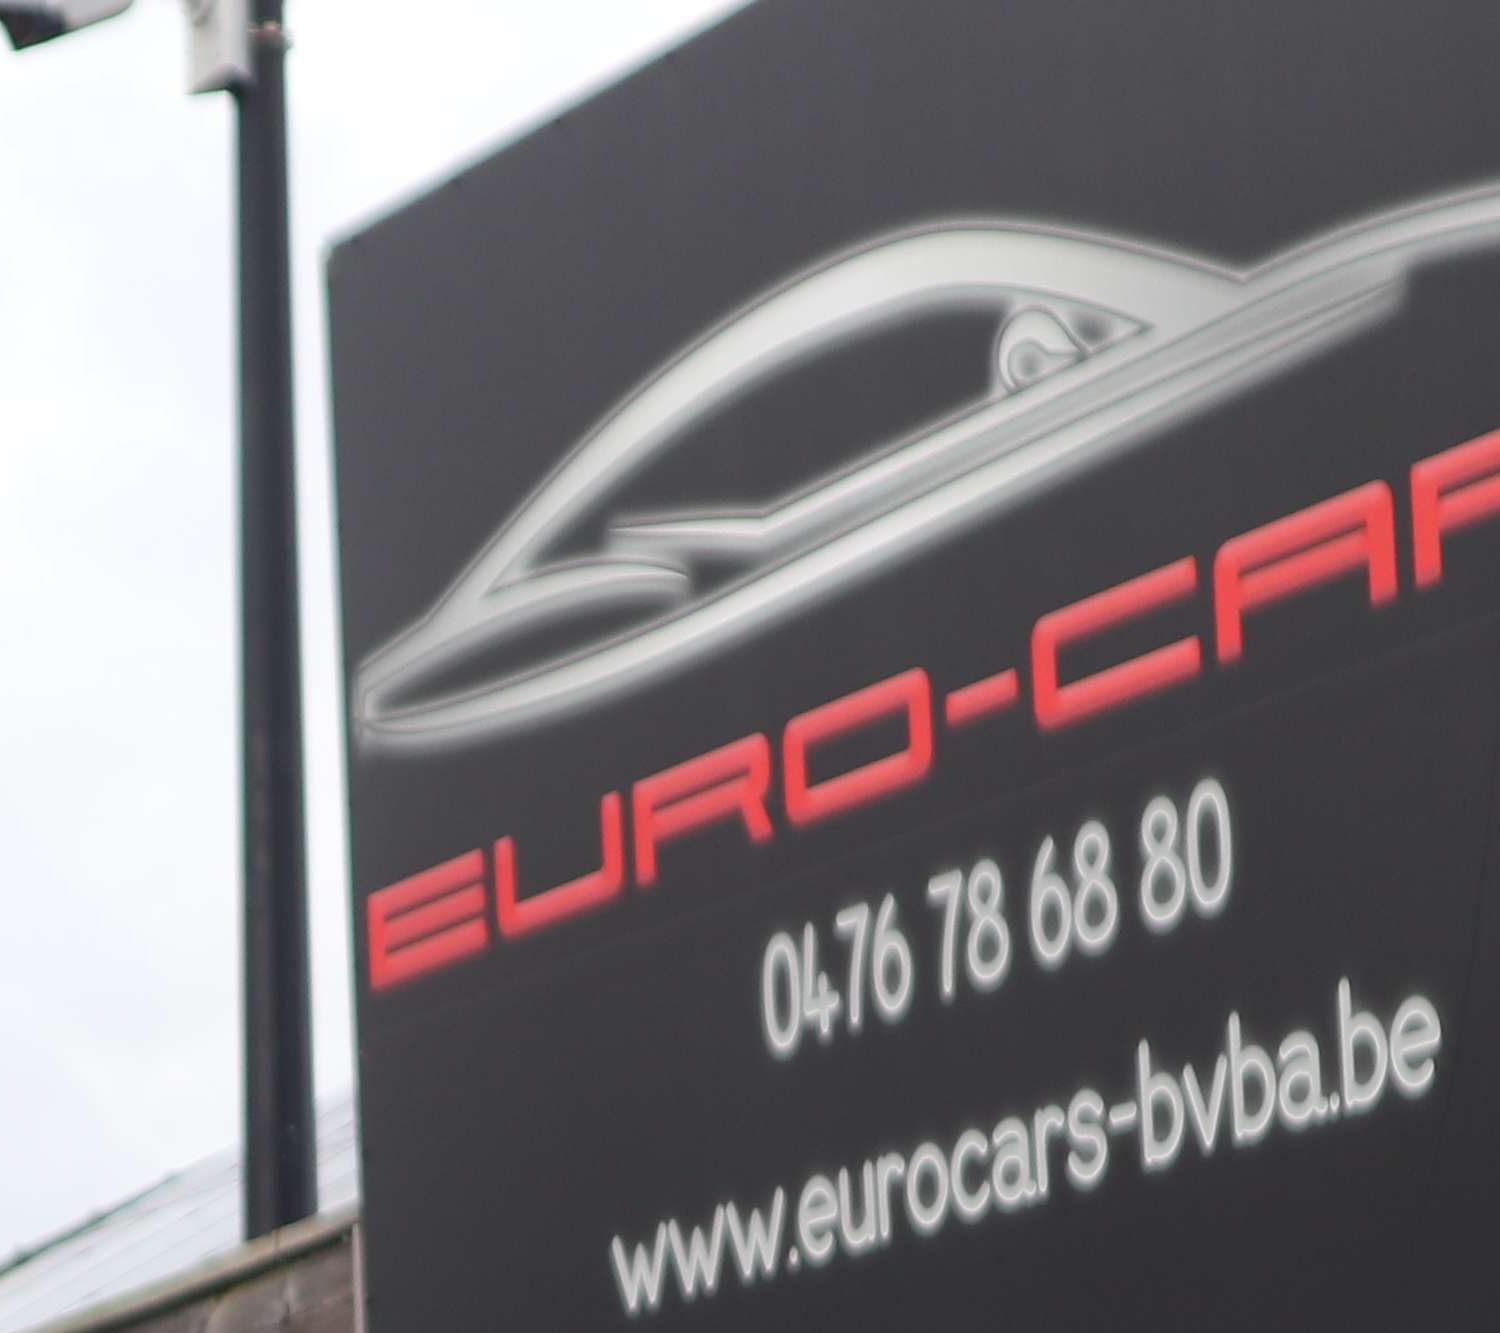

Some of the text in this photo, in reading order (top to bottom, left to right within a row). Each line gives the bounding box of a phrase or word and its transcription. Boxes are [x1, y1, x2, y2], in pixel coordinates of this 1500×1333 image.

[761, 777, 1233, 1057] 0476 78 68 80
[611, 977, 1442, 1314] www.eurocars-bvba.be
